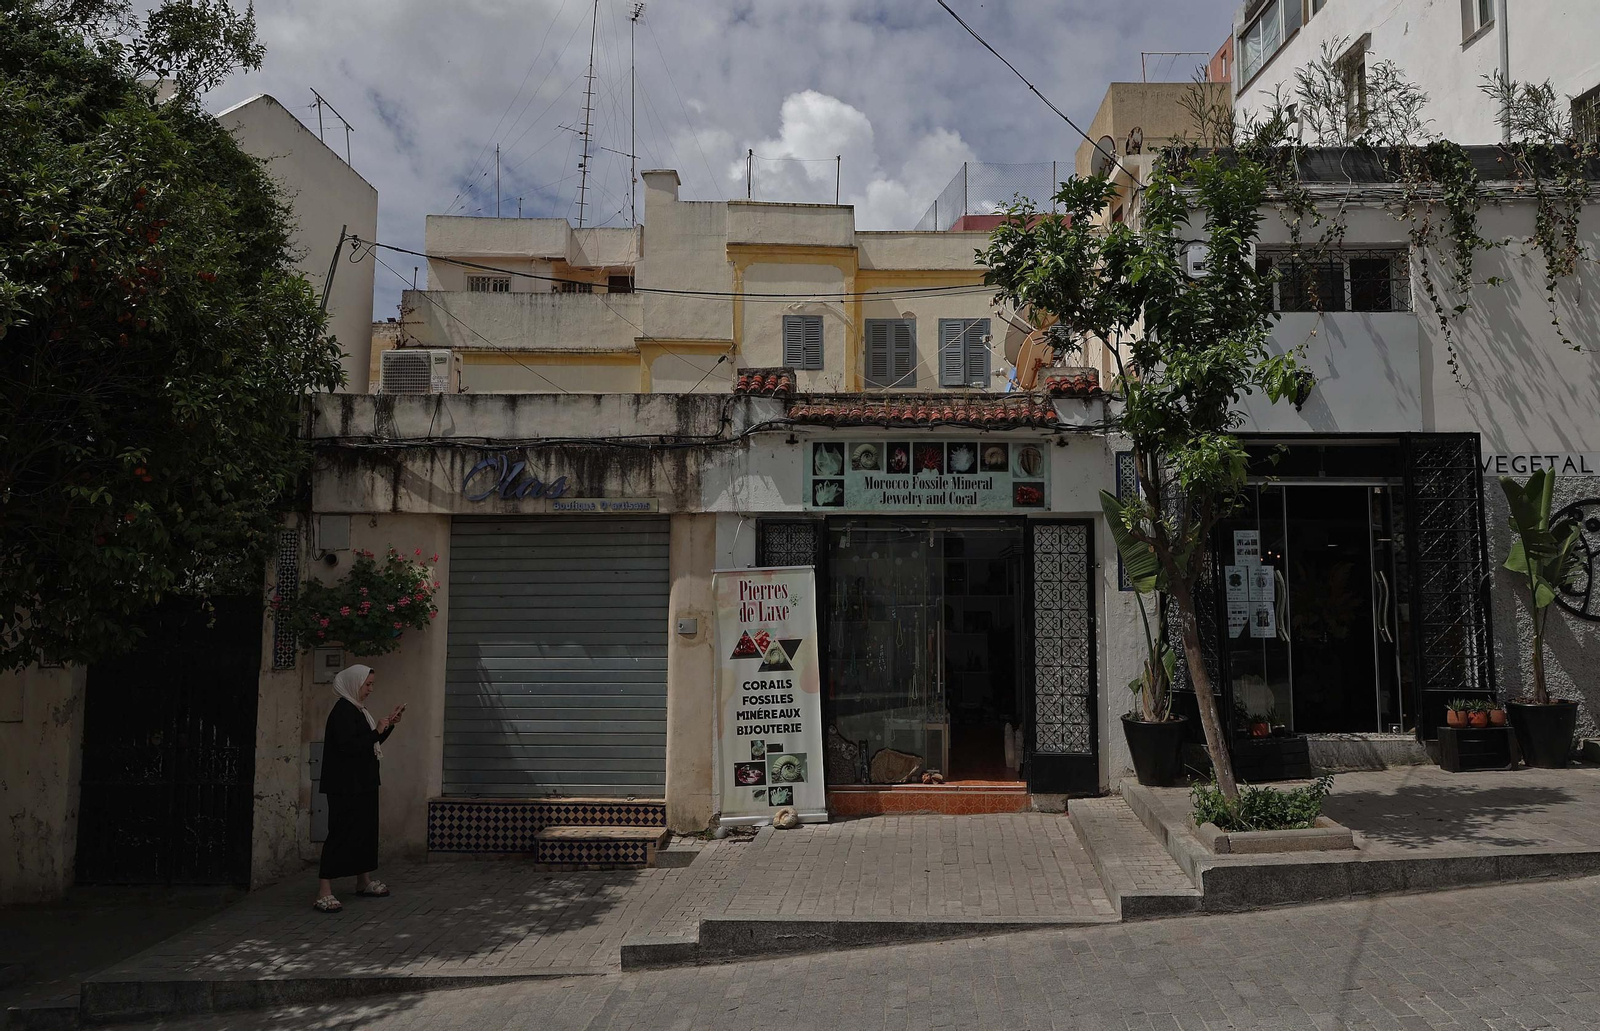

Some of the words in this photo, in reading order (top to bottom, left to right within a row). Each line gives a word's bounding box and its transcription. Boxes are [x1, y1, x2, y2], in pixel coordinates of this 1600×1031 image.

[865, 476, 909, 490] Morocco
[912, 476, 949, 490] Fossile
[952, 476, 993, 490] Mineral
[880, 491, 924, 507] Jewelry
[926, 491, 946, 505] and
[949, 491, 977, 505] Coral
[553, 501, 596, 512] Boutique
[600, 501, 650, 511] D'artisans
[739, 580, 788, 601] Pierres
[739, 602, 755, 623] de
[758, 601, 790, 622] Luxe
[742, 679, 793, 691] CORAILS
[742, 694, 794, 706] FOSSILES
[736, 707, 801, 721] MINÉREAUX
[736, 723, 802, 736] BIJOUTERIE
